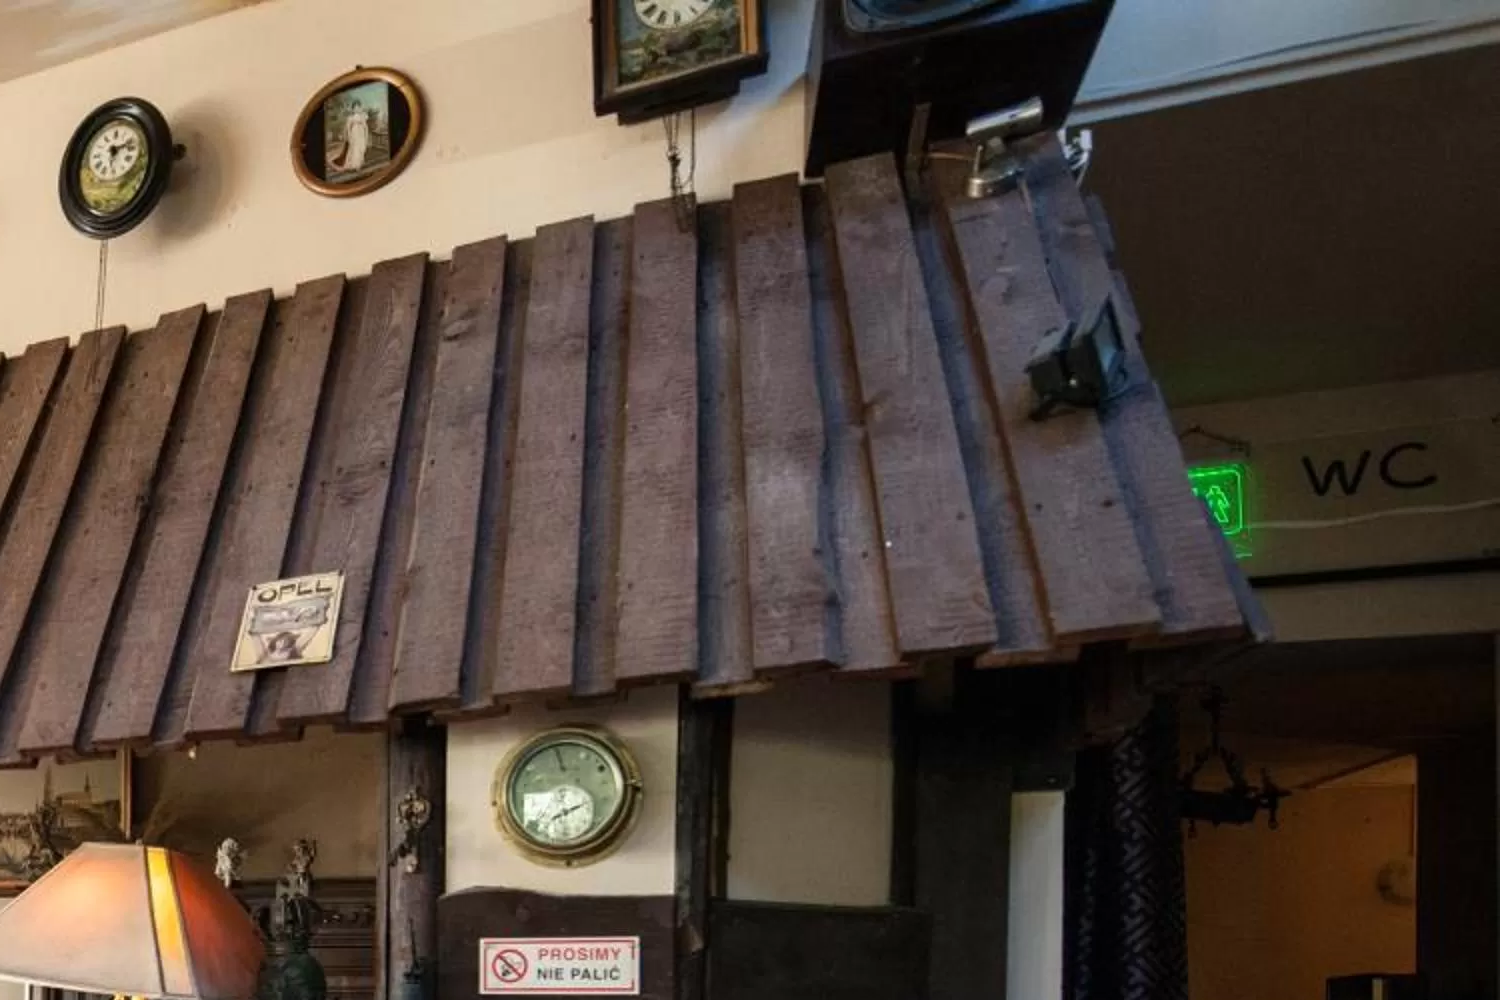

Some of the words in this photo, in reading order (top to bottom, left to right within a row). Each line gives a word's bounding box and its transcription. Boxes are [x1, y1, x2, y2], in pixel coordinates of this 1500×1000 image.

[1302, 442, 1438, 496] WC
[258, 579, 332, 602] OPEL
[538, 947, 621, 960] PROSIMY
[537, 966, 564, 981] NIE
[571, 965, 621, 981] PALIĆ
